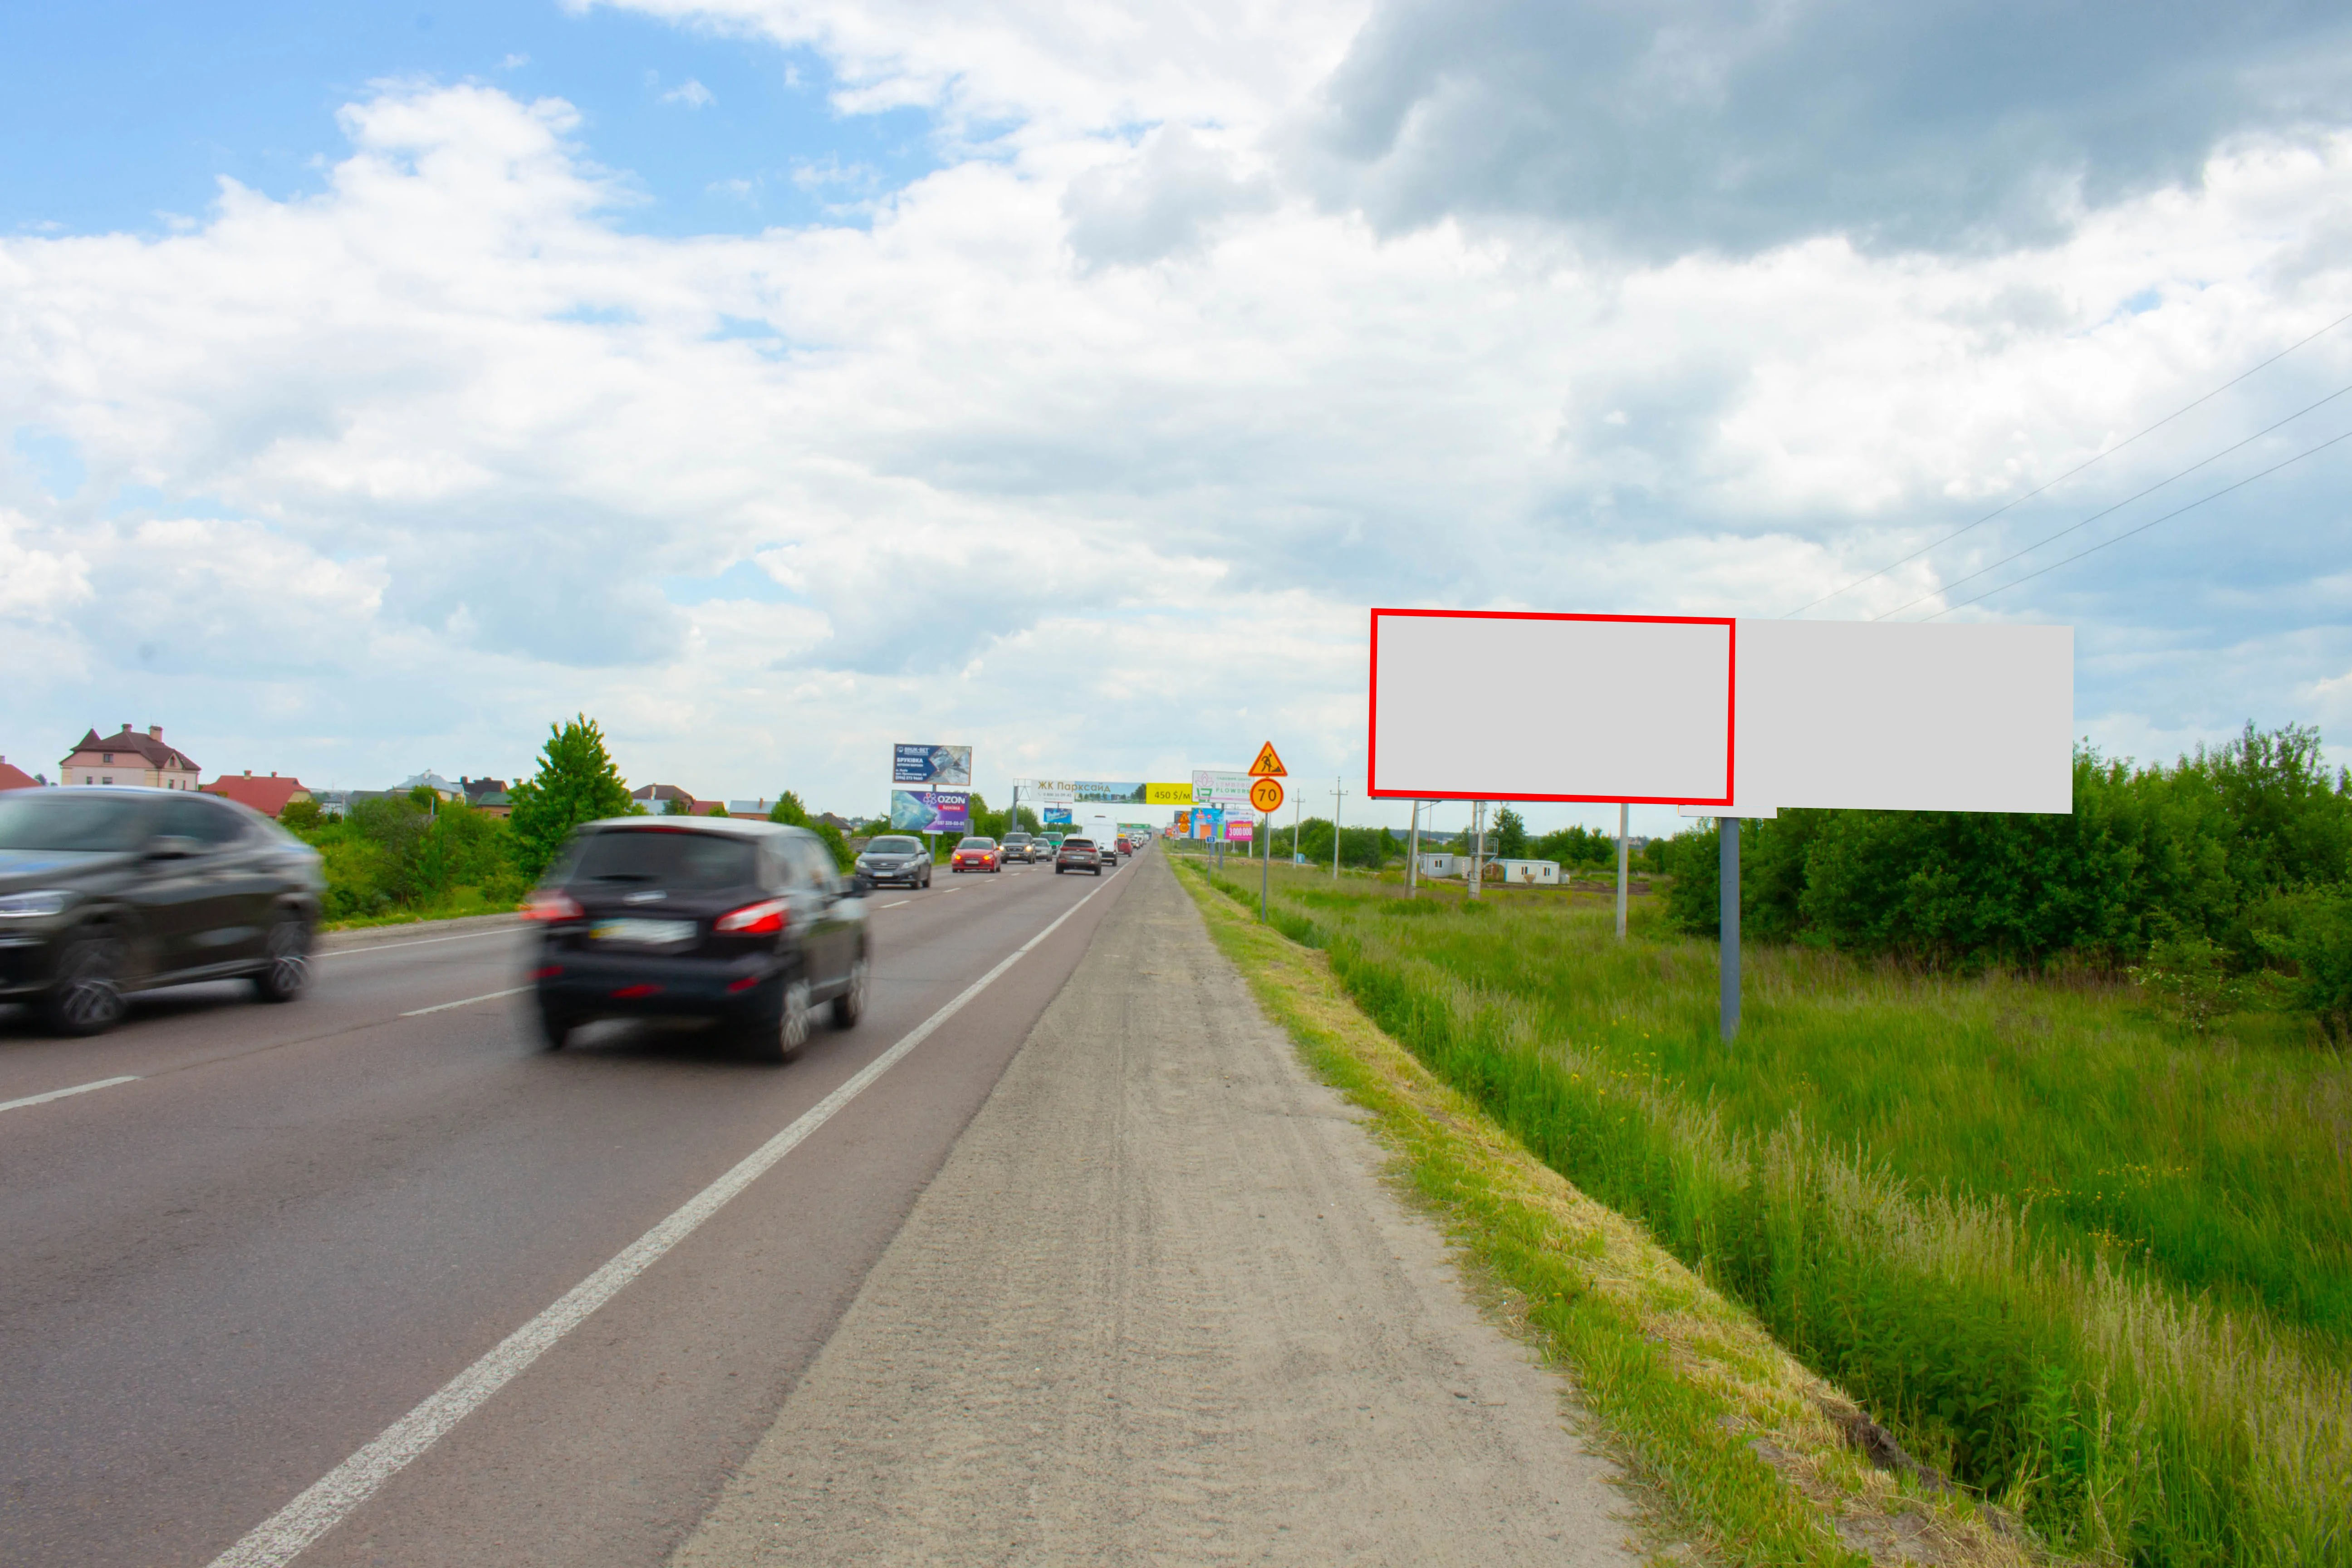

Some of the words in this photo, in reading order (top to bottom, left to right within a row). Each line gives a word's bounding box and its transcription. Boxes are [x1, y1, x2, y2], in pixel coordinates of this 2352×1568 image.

[1038, 781, 1054, 790] ЖК
[1058, 782, 1111, 792] Парксайд
[937, 796, 965, 804] OZON
[1259, 789, 1277, 802] 70
